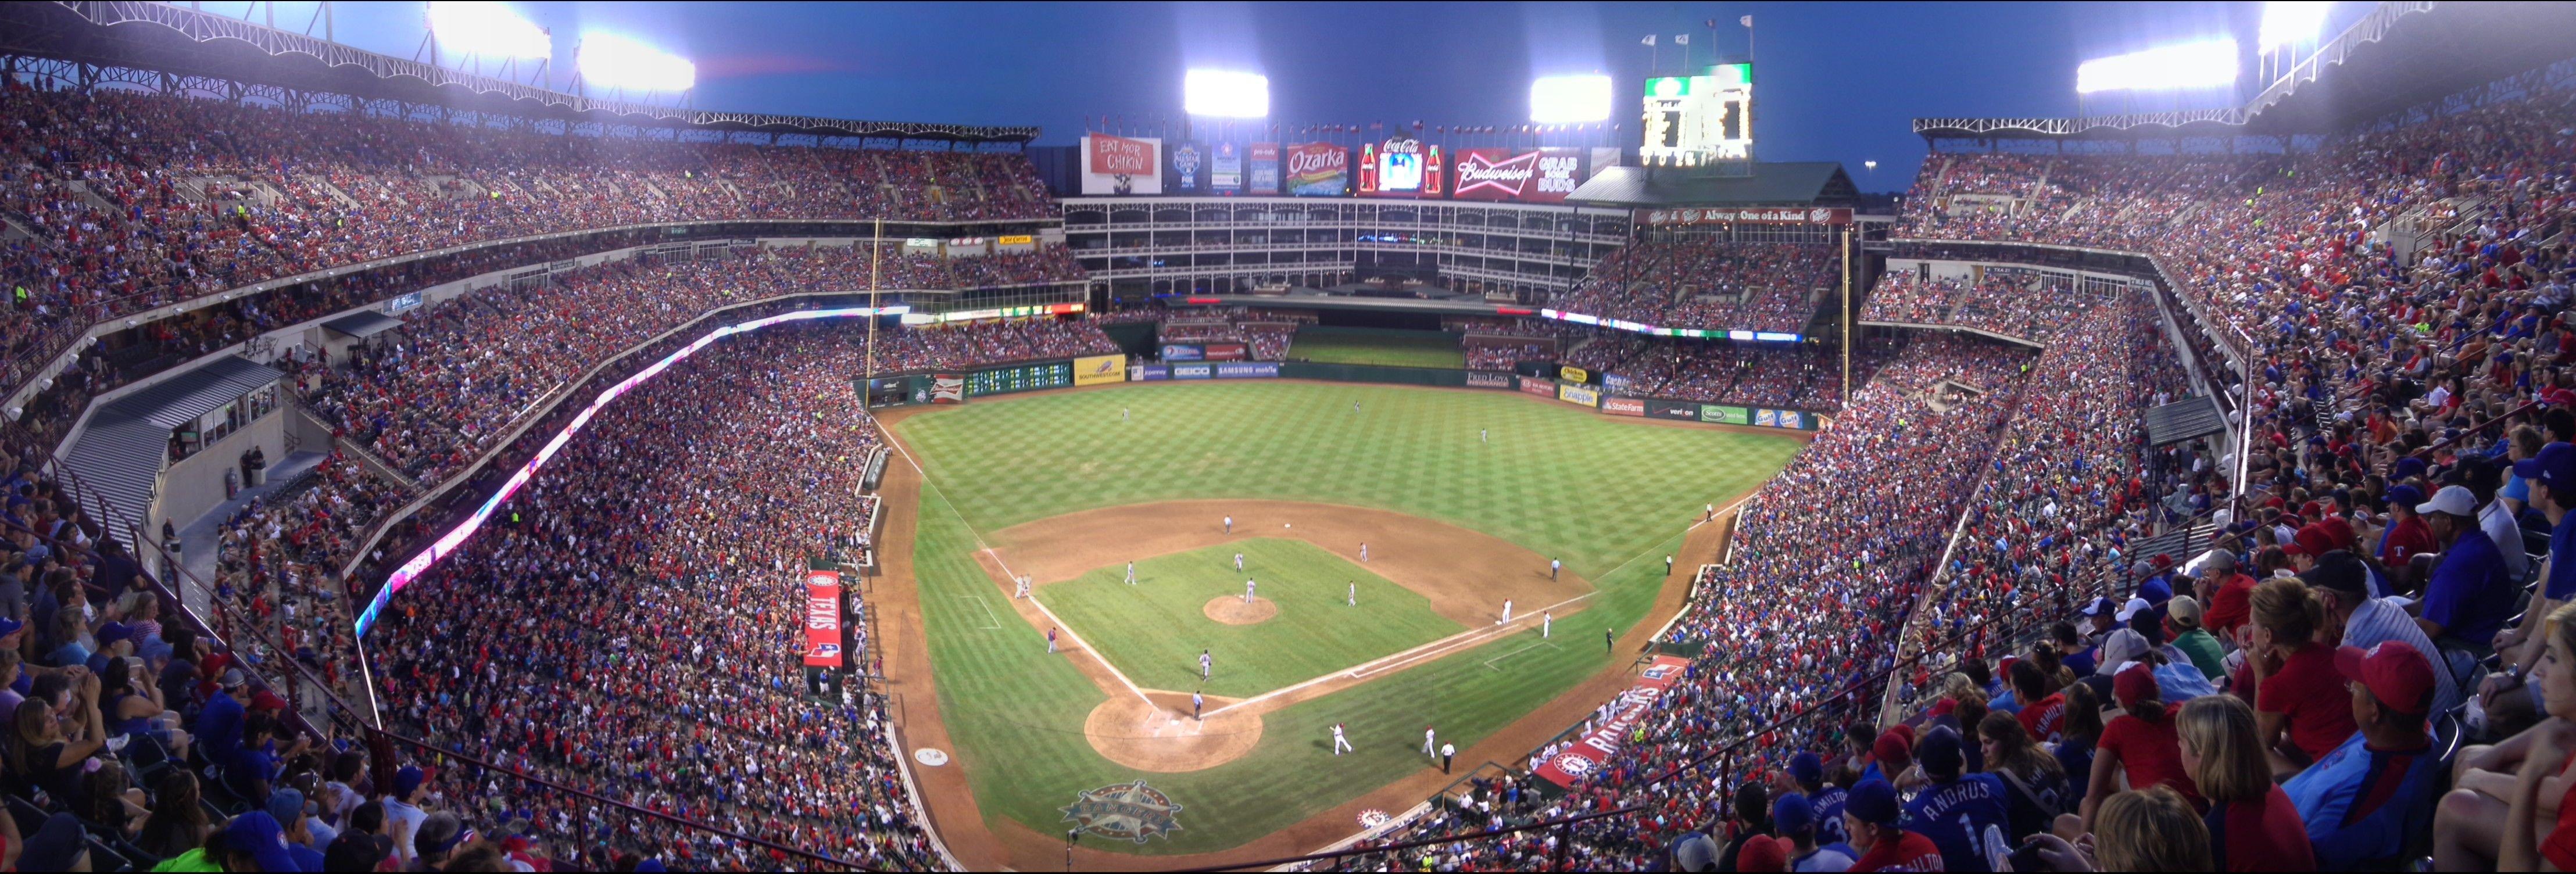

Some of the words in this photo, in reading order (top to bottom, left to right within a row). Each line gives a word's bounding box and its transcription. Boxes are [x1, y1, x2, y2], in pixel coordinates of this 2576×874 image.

[1100, 140, 1119, 153] EAT
[1121, 142, 1141, 156] MOR
[1107, 154, 1143, 170] CHIKIN
[1289, 149, 1344, 174] Ozarka
[1539, 157, 1577, 170] GRAB
[1458, 162, 1533, 181] Budweiser
[1538, 178, 1575, 192] BUDS
[1740, 212, 1760, 220] One
[1761, 212, 1772, 220] of
[1780, 211, 1805, 220] Kind
[1079, 371, 1121, 380] SOUTHWEST.COM
[1174, 367, 1210, 375] GEICO
[1218, 366, 1253, 375] SAMSUNG
[1564, 367, 1583, 376] Chicken
[1489, 374, 1508, 382] LOYA
[1564, 389, 1593, 403] Snapple
[1705, 409, 1722, 417] Scotts
[1758, 413, 1774, 422] Gulf
[1781, 415, 1798, 424] Gulf
[2393, 546, 2405, 557] T
[809, 597, 837, 630] TEXAS
[1813, 791, 1847, 822] HAMILTO
[1923, 782, 1990, 822] ANDRUS
[1080, 804, 1164, 825] RANGERS
[1958, 813, 1981, 857] 1
